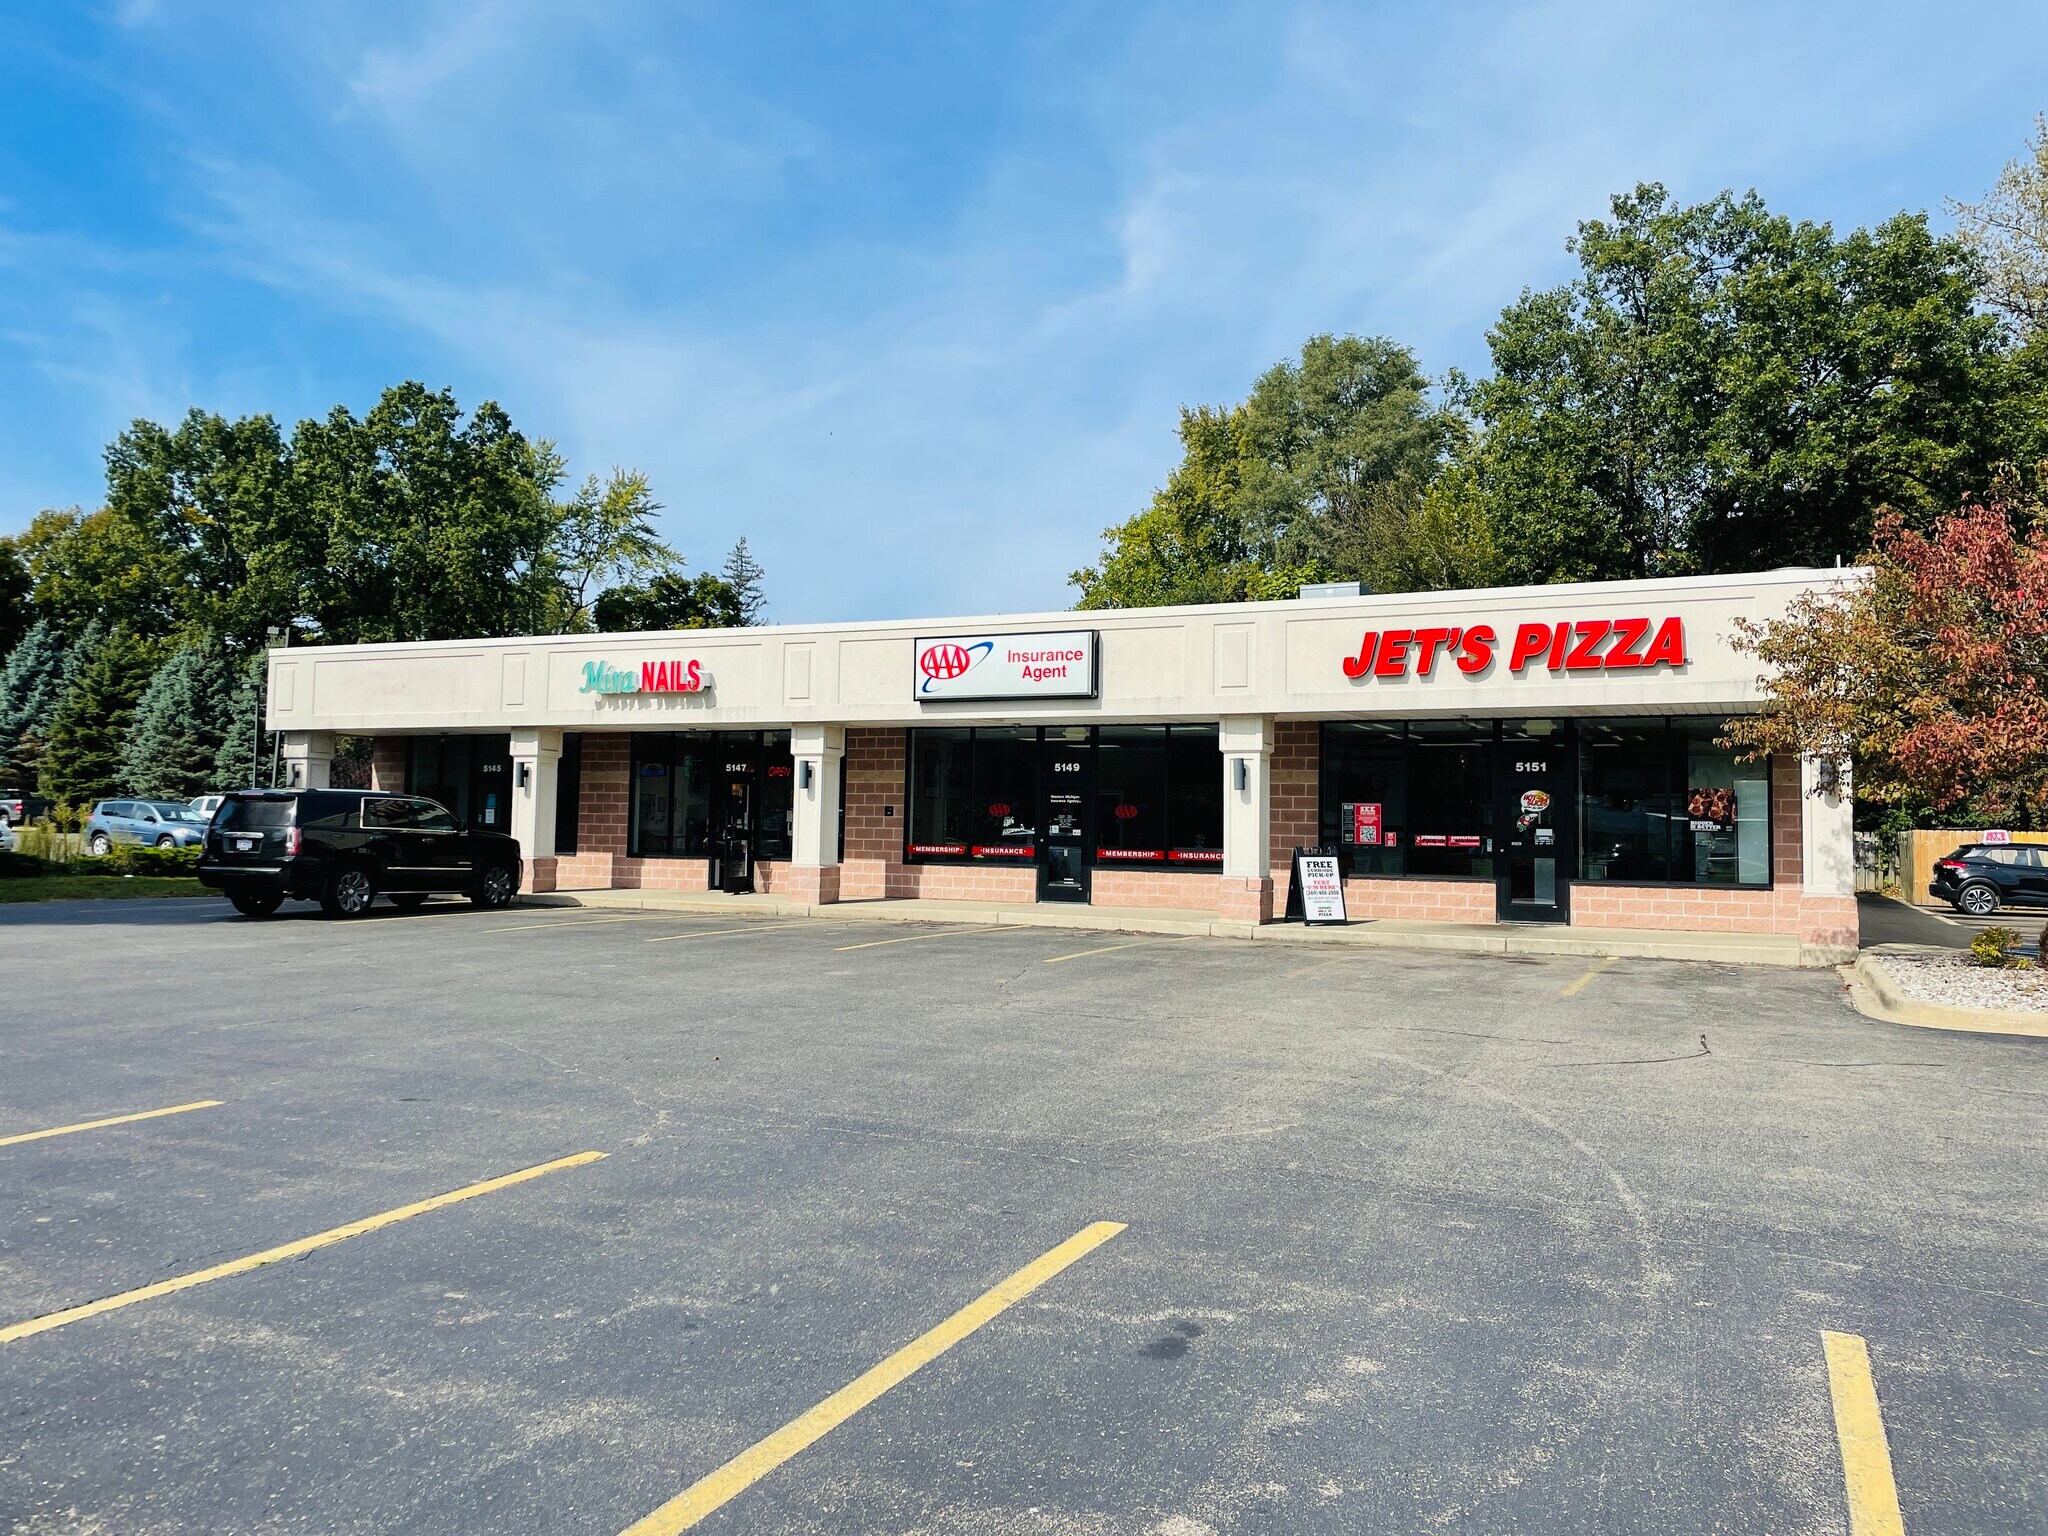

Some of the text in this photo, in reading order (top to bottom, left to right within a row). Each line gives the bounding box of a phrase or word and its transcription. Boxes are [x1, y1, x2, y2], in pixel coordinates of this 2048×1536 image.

[1343, 617, 1685, 678] JET'S PIZZA
[921, 644, 970, 679] AAA
[1007, 649, 1083, 663] Insurance
[579, 659, 700, 694] Mira NAILS
[1022, 665, 1067, 682] Agent
[726, 764, 747, 772] 5147
[767, 766, 791, 777] OPEN
[1054, 763, 1080, 772] 5149
[1515, 762, 1547, 772] 5151
[1115, 804, 1138, 818] AAA
[1105, 850, 1155, 858] MEMBERSHIP
